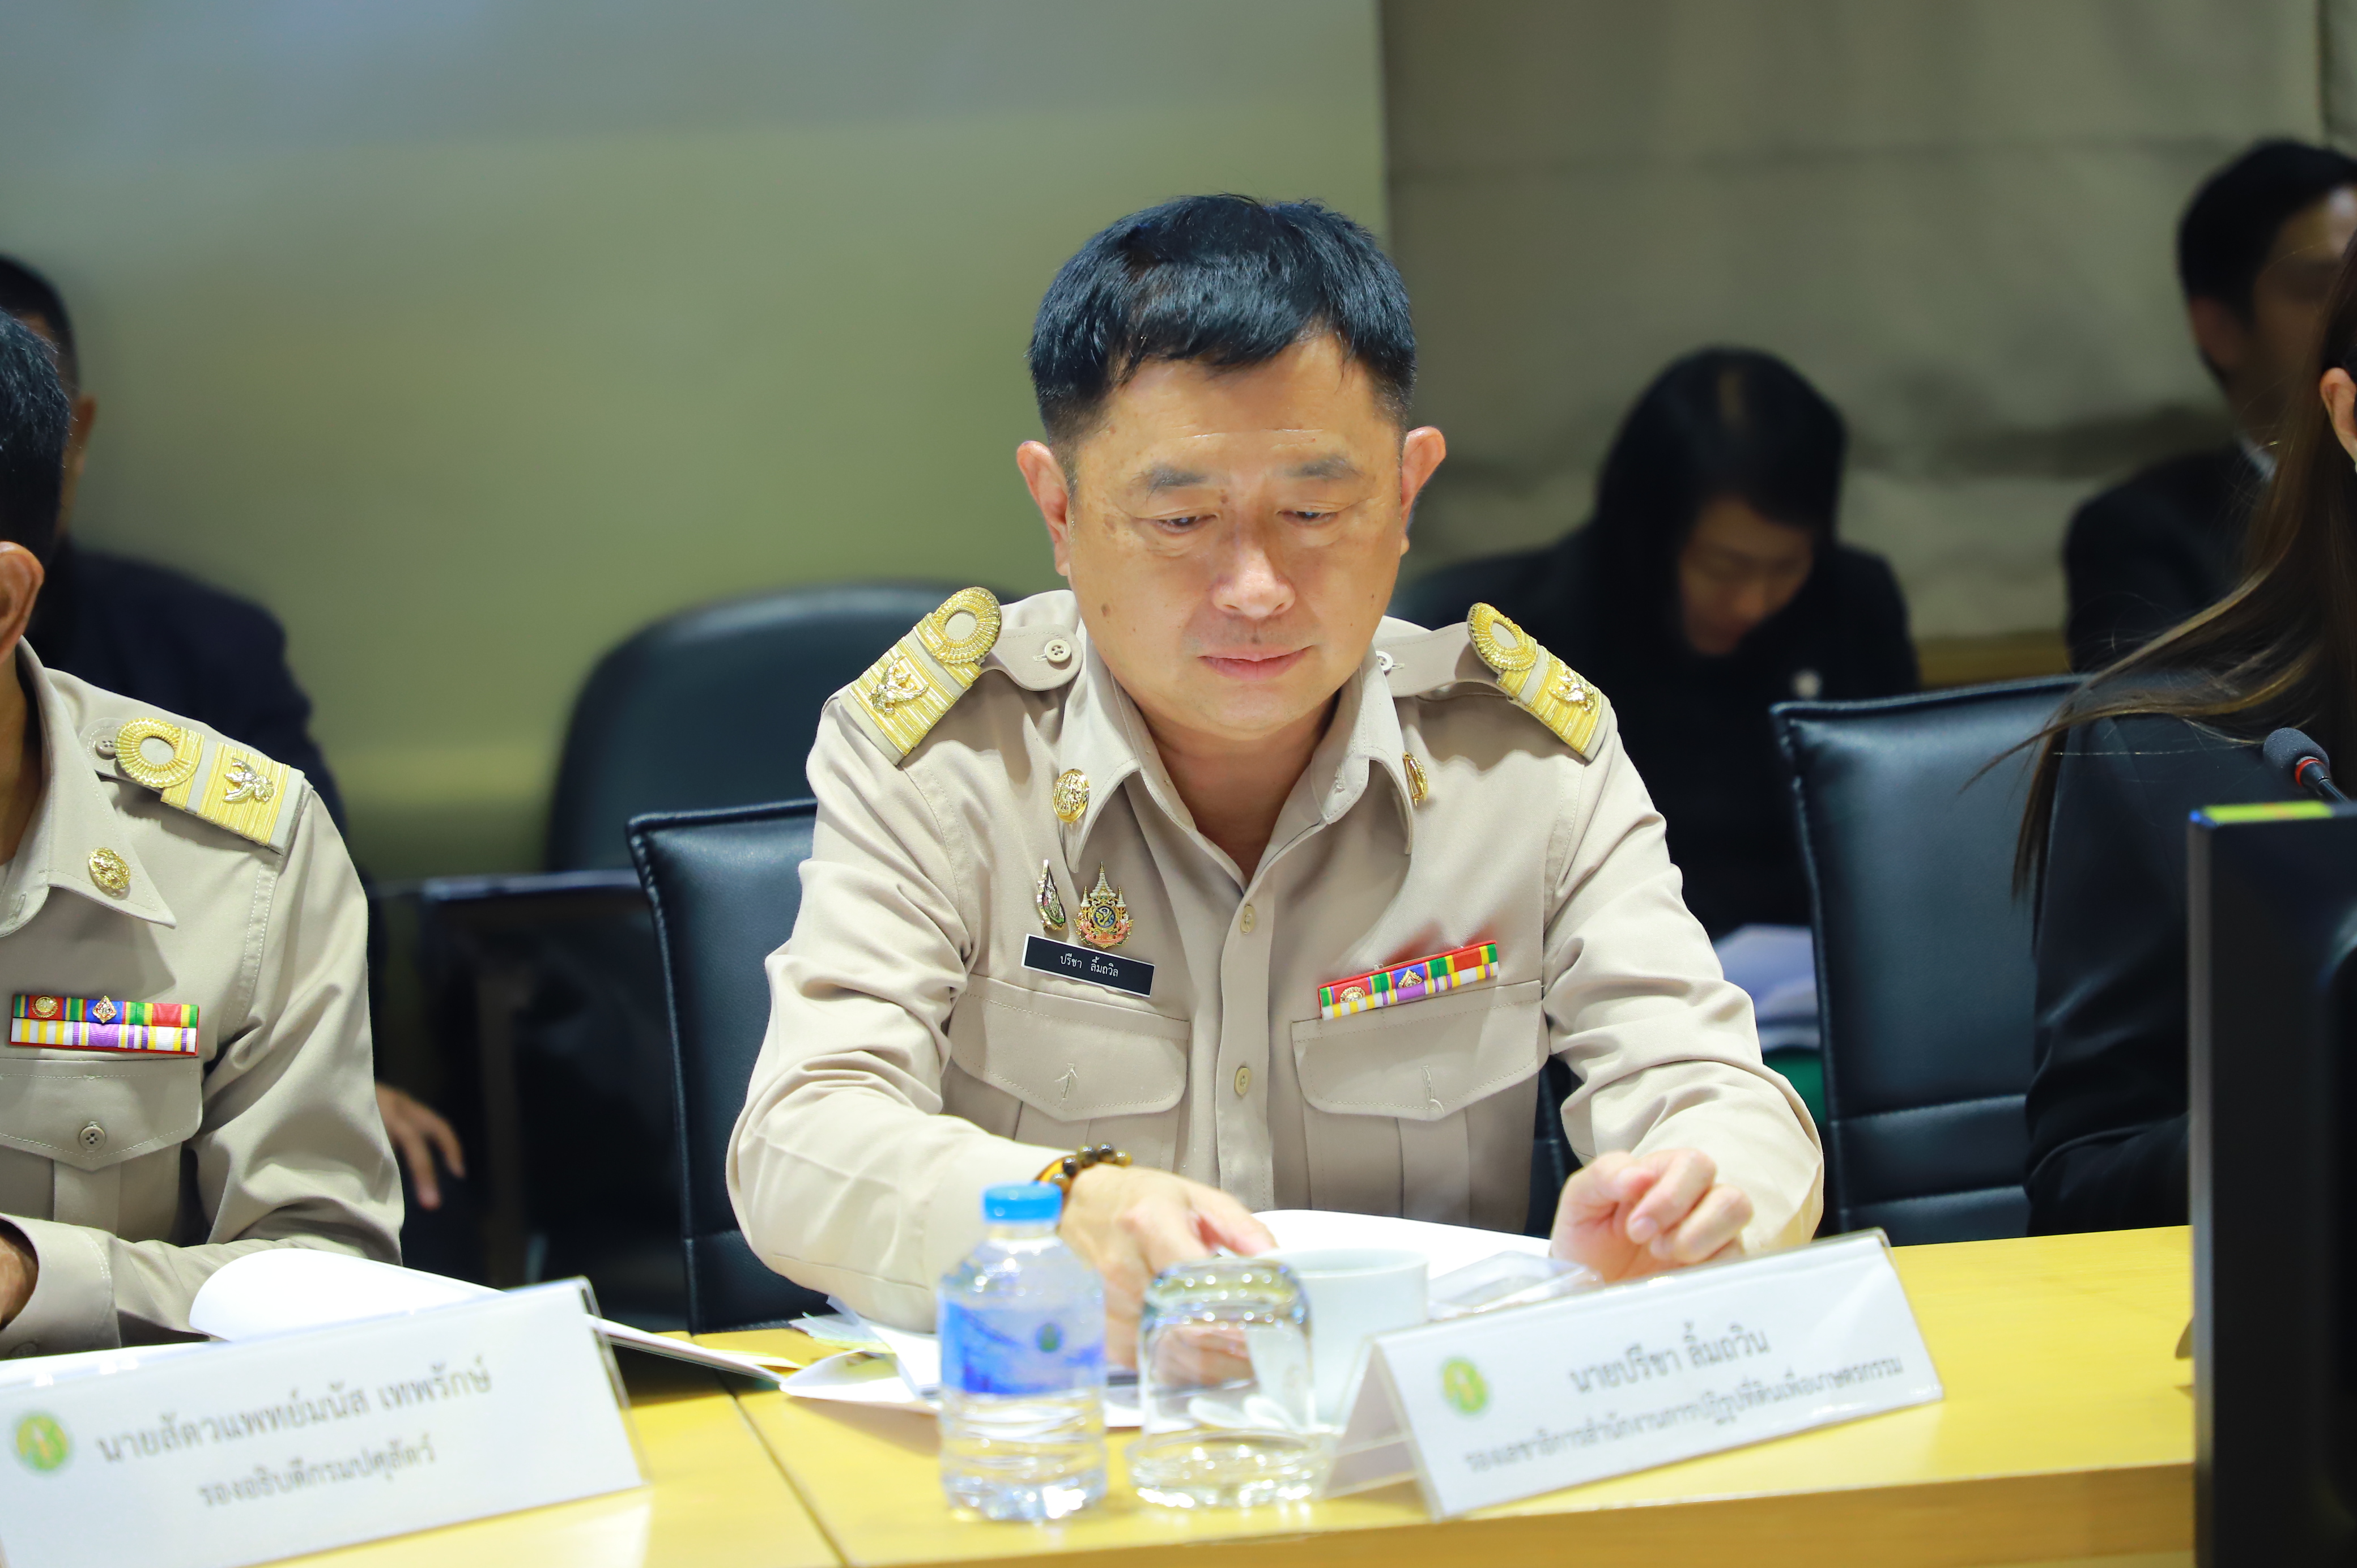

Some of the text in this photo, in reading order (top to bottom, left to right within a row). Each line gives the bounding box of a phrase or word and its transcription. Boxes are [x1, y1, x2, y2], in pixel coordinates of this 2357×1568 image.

[1060, 953, 1119, 977] ปรีชา ลิ้มถวิล
[1569, 1342, 1682, 1392] นายปรีชา
